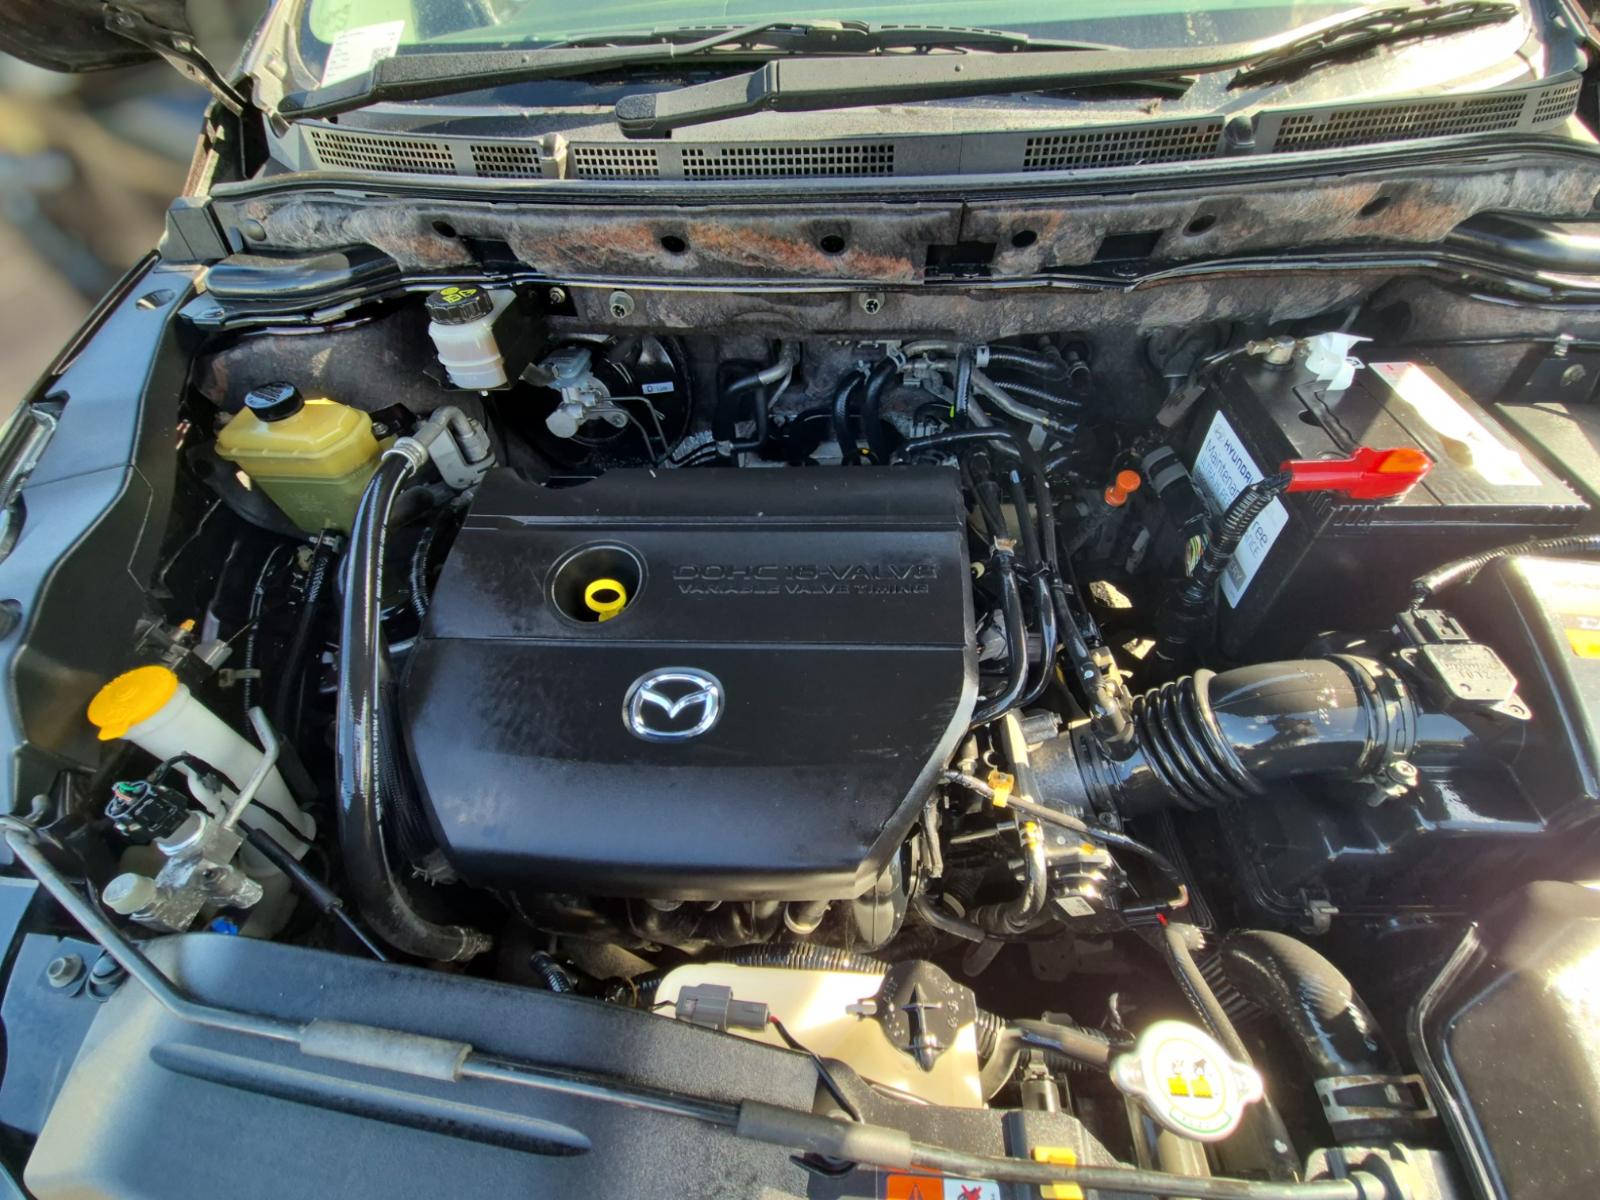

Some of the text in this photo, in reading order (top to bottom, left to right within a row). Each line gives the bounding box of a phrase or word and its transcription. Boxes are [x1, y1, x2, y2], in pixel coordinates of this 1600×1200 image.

[1252, 521, 1268, 548] ree
[672, 564, 779, 580] DOHC
[678, 584, 929, 594] VARIABLE VALVE TIMING
